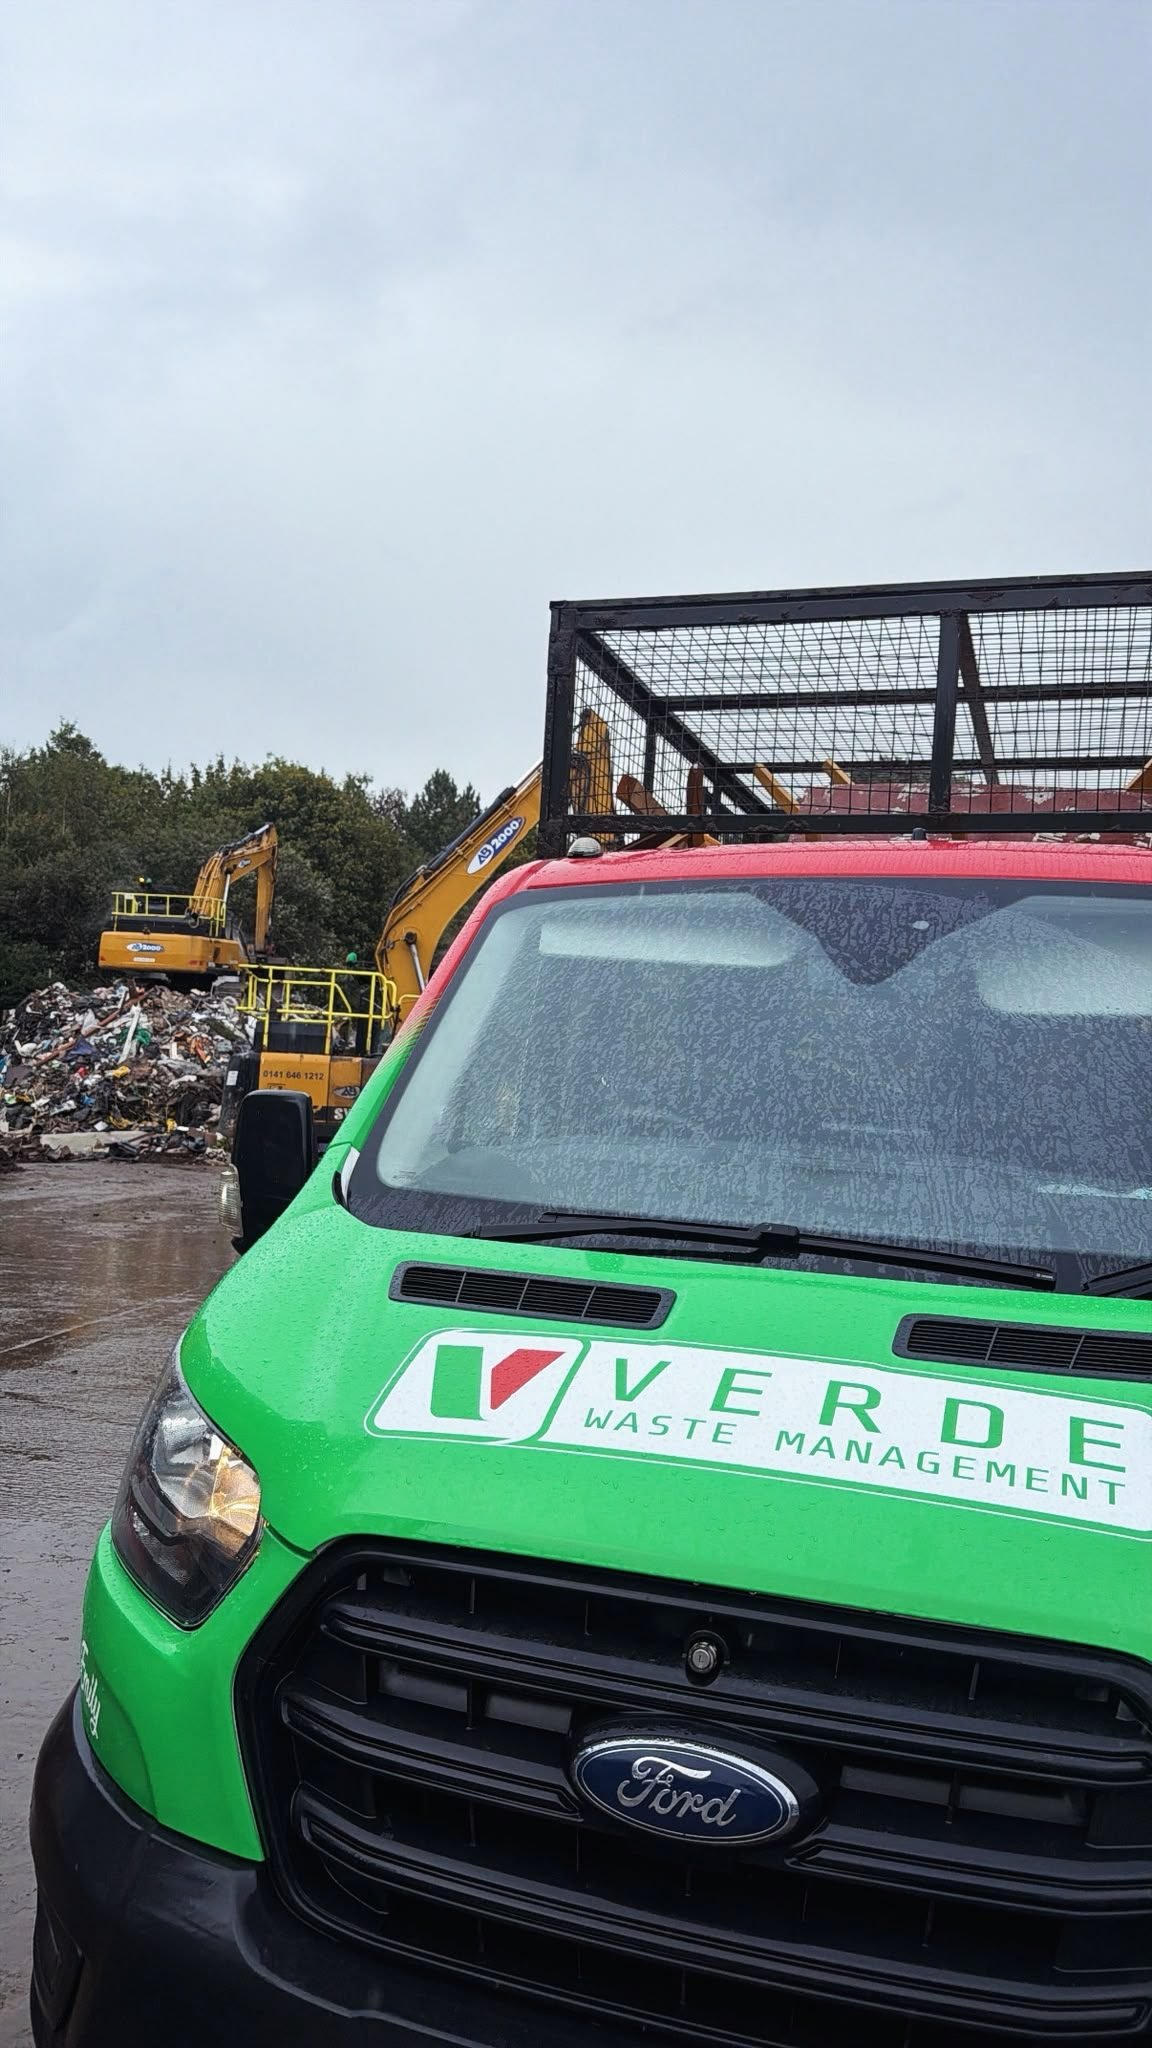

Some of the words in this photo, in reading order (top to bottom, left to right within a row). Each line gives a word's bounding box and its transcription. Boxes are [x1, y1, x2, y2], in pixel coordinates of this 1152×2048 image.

[263, 1070, 283, 1079] 0141
[286, 1071, 302, 1080] 646
[304, 1072, 325, 1081] 1212
[583, 1408, 737, 1446] WASTE
[775, 1430, 1125, 1505] MANAGEMENT
[615, 1358, 1127, 1473] VERDE
[616, 1756, 742, 1827] Ford
